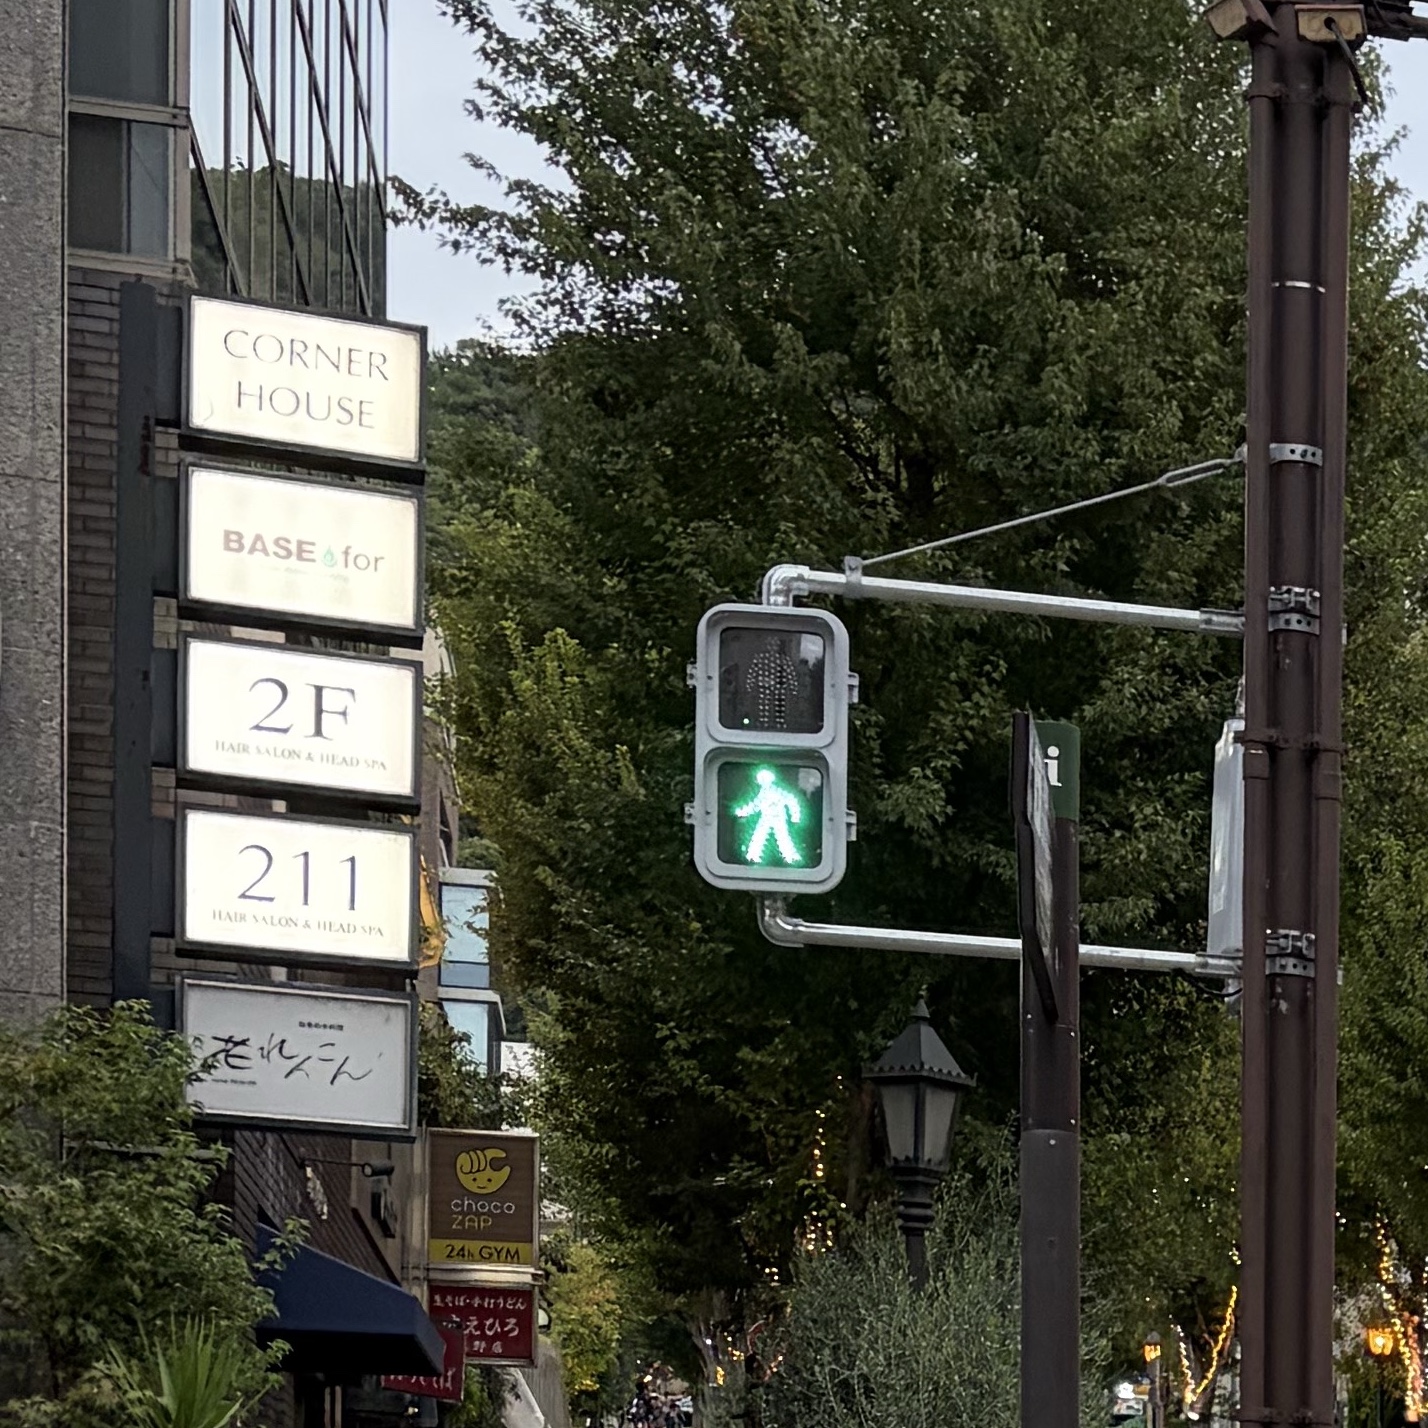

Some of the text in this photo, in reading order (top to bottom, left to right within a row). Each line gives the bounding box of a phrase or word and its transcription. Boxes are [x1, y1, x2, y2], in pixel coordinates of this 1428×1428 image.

[223, 329, 389, 381] CORNER
[237, 380, 375, 429] HOUSE
[222, 528, 385, 572] BASE for
[248, 677, 357, 741] 2F
[215, 740, 251, 755] HAIR
[320, 754, 360, 768] HEAD
[237, 844, 356, 911] 211
[212, 909, 248, 924] HAIR
[451, 1196, 516, 1214] choco
[451, 1215, 493, 1231] ZAP
[445, 1244, 521, 1262] 24h GYM
